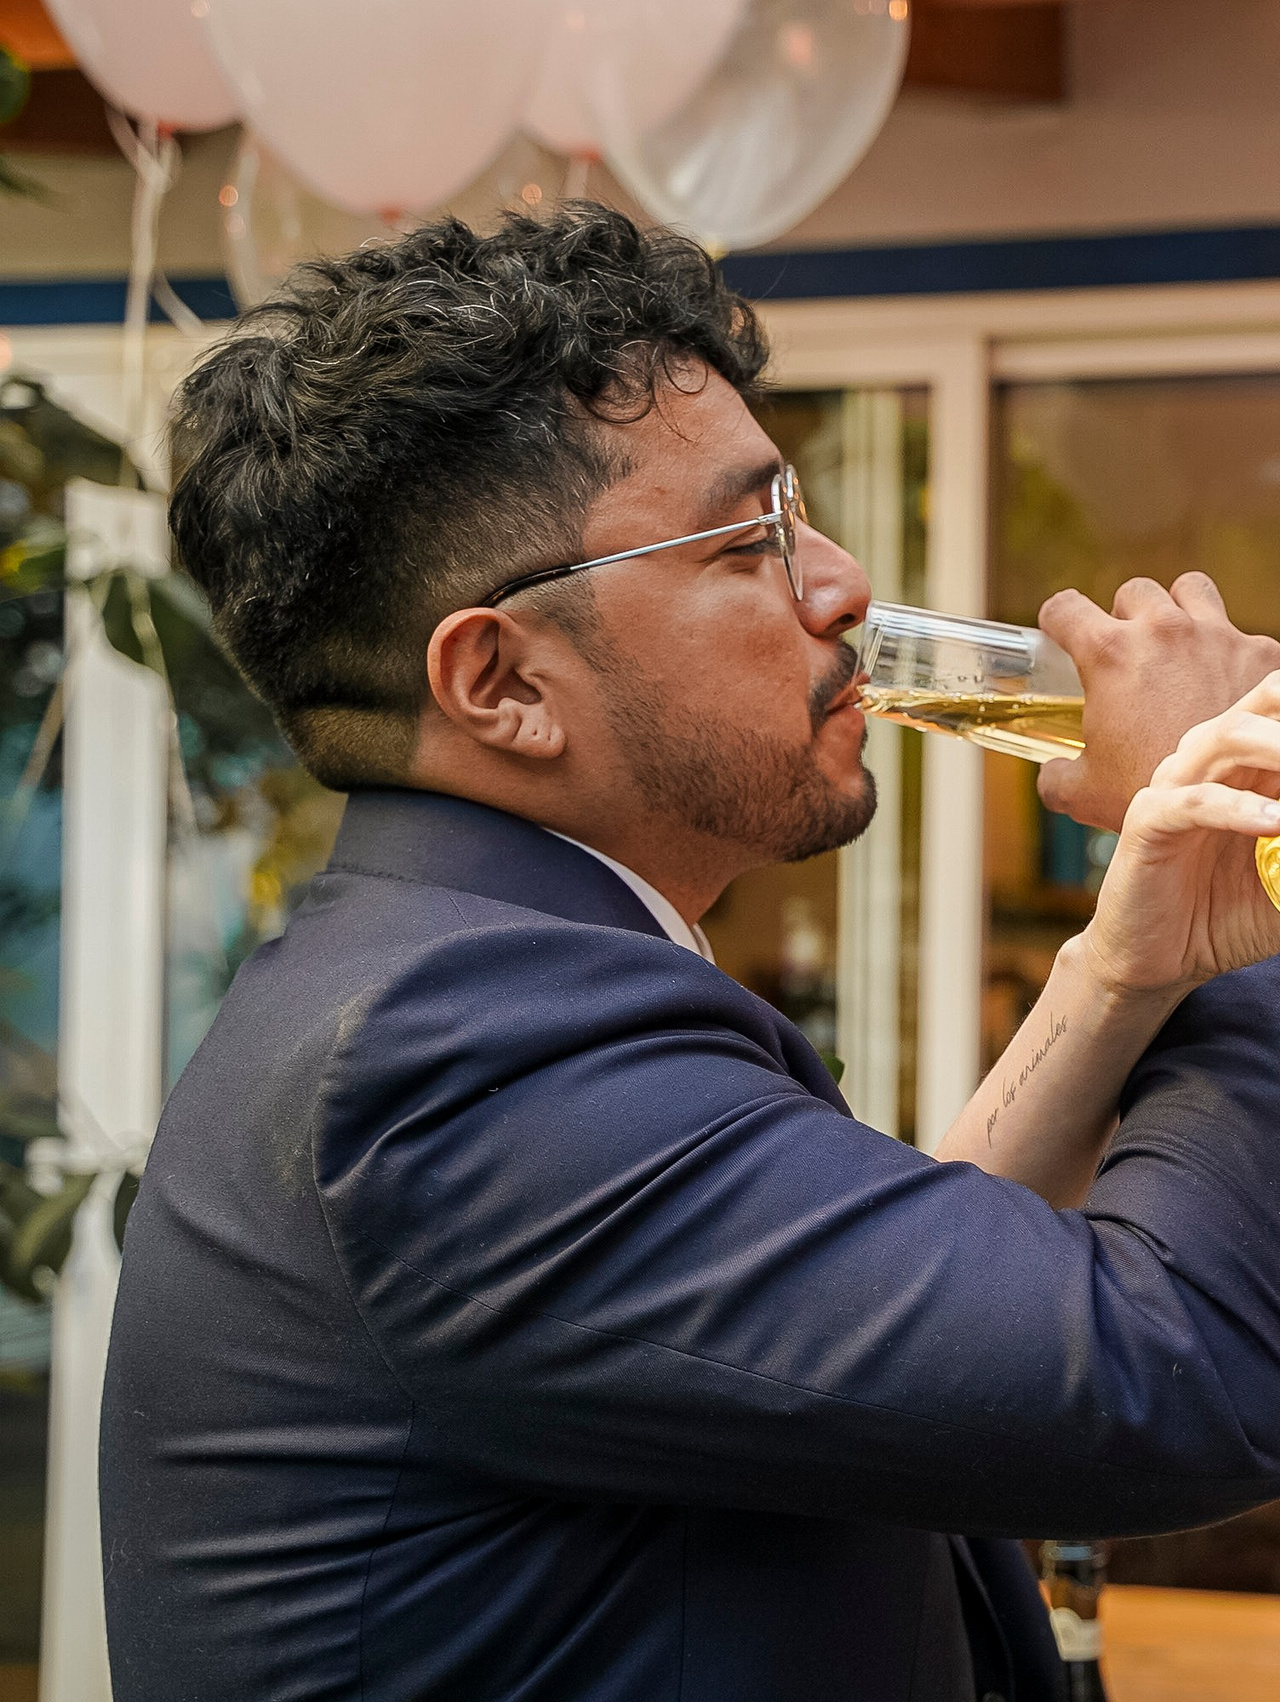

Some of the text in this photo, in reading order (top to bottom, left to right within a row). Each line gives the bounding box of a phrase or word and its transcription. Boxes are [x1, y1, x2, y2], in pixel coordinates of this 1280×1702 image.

[986, 1012, 1067, 1149] por los animales
